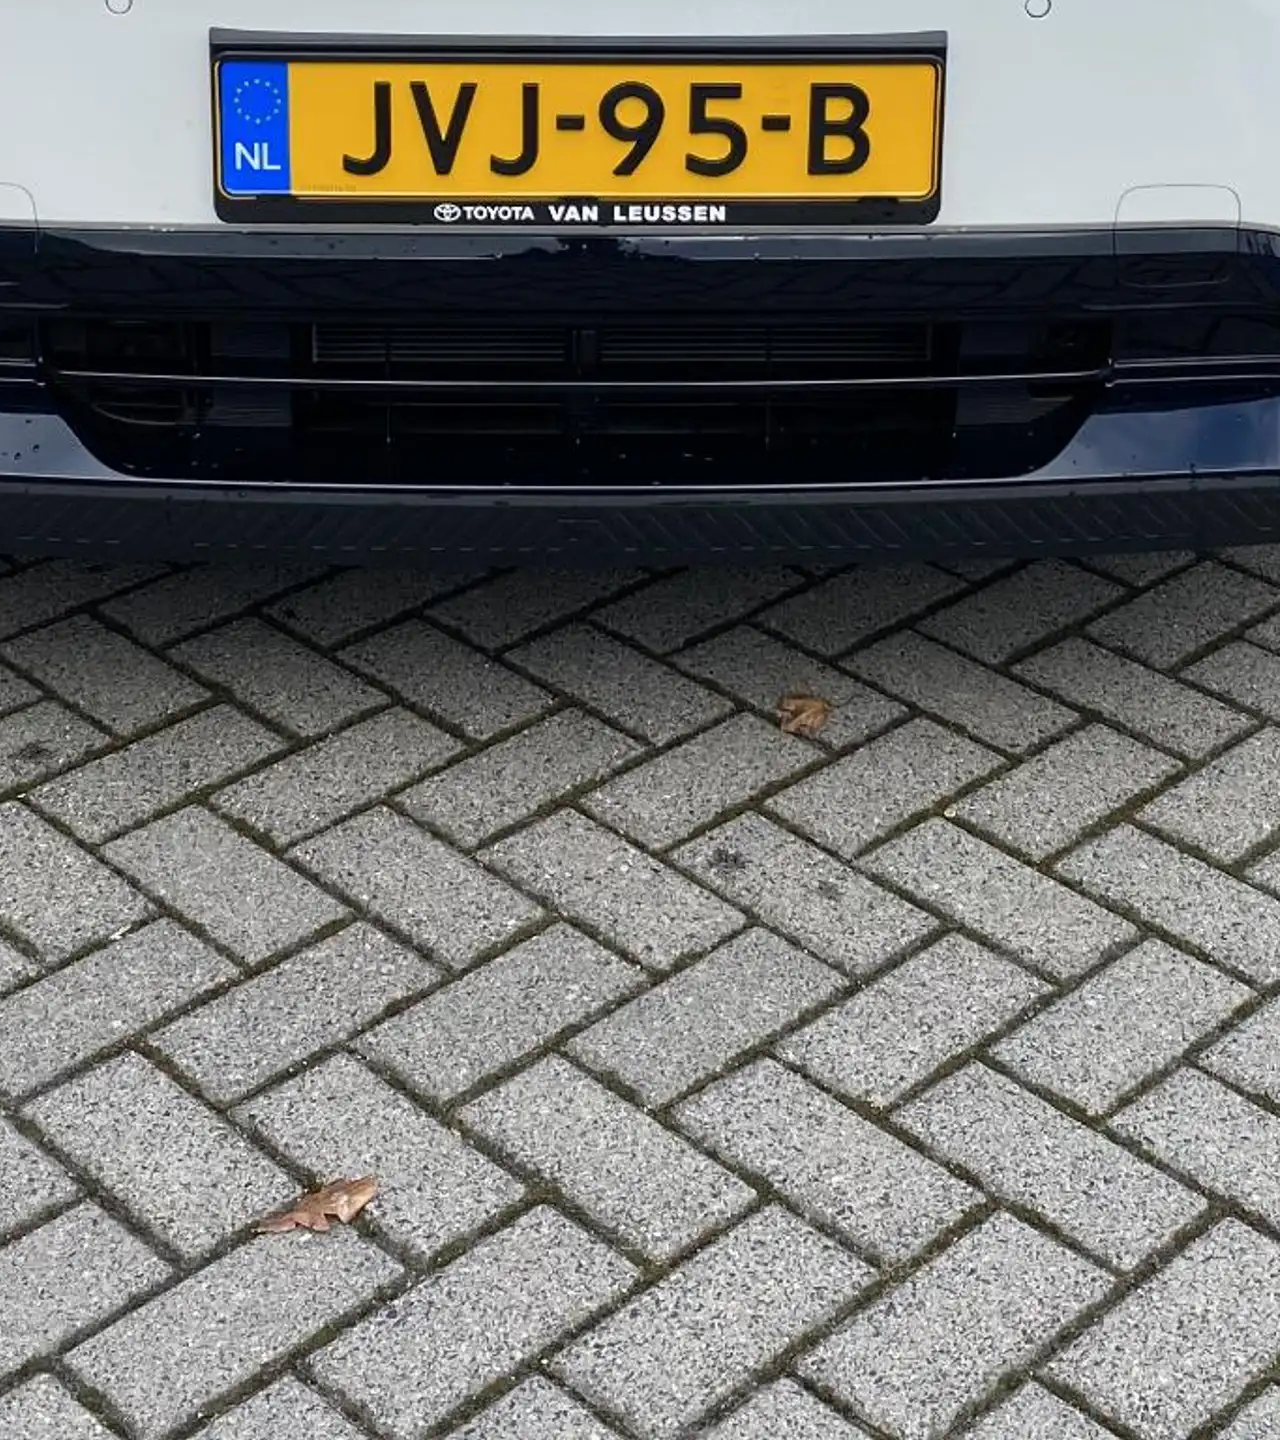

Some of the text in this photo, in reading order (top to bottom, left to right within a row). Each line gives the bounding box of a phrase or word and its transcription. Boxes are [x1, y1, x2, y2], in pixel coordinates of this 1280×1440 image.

[343, 81, 870, 176] JVJ-95-B
[235, 142, 280, 171] NL
[463, 206, 726, 222] TOYOTA VAN LEUSSEN
